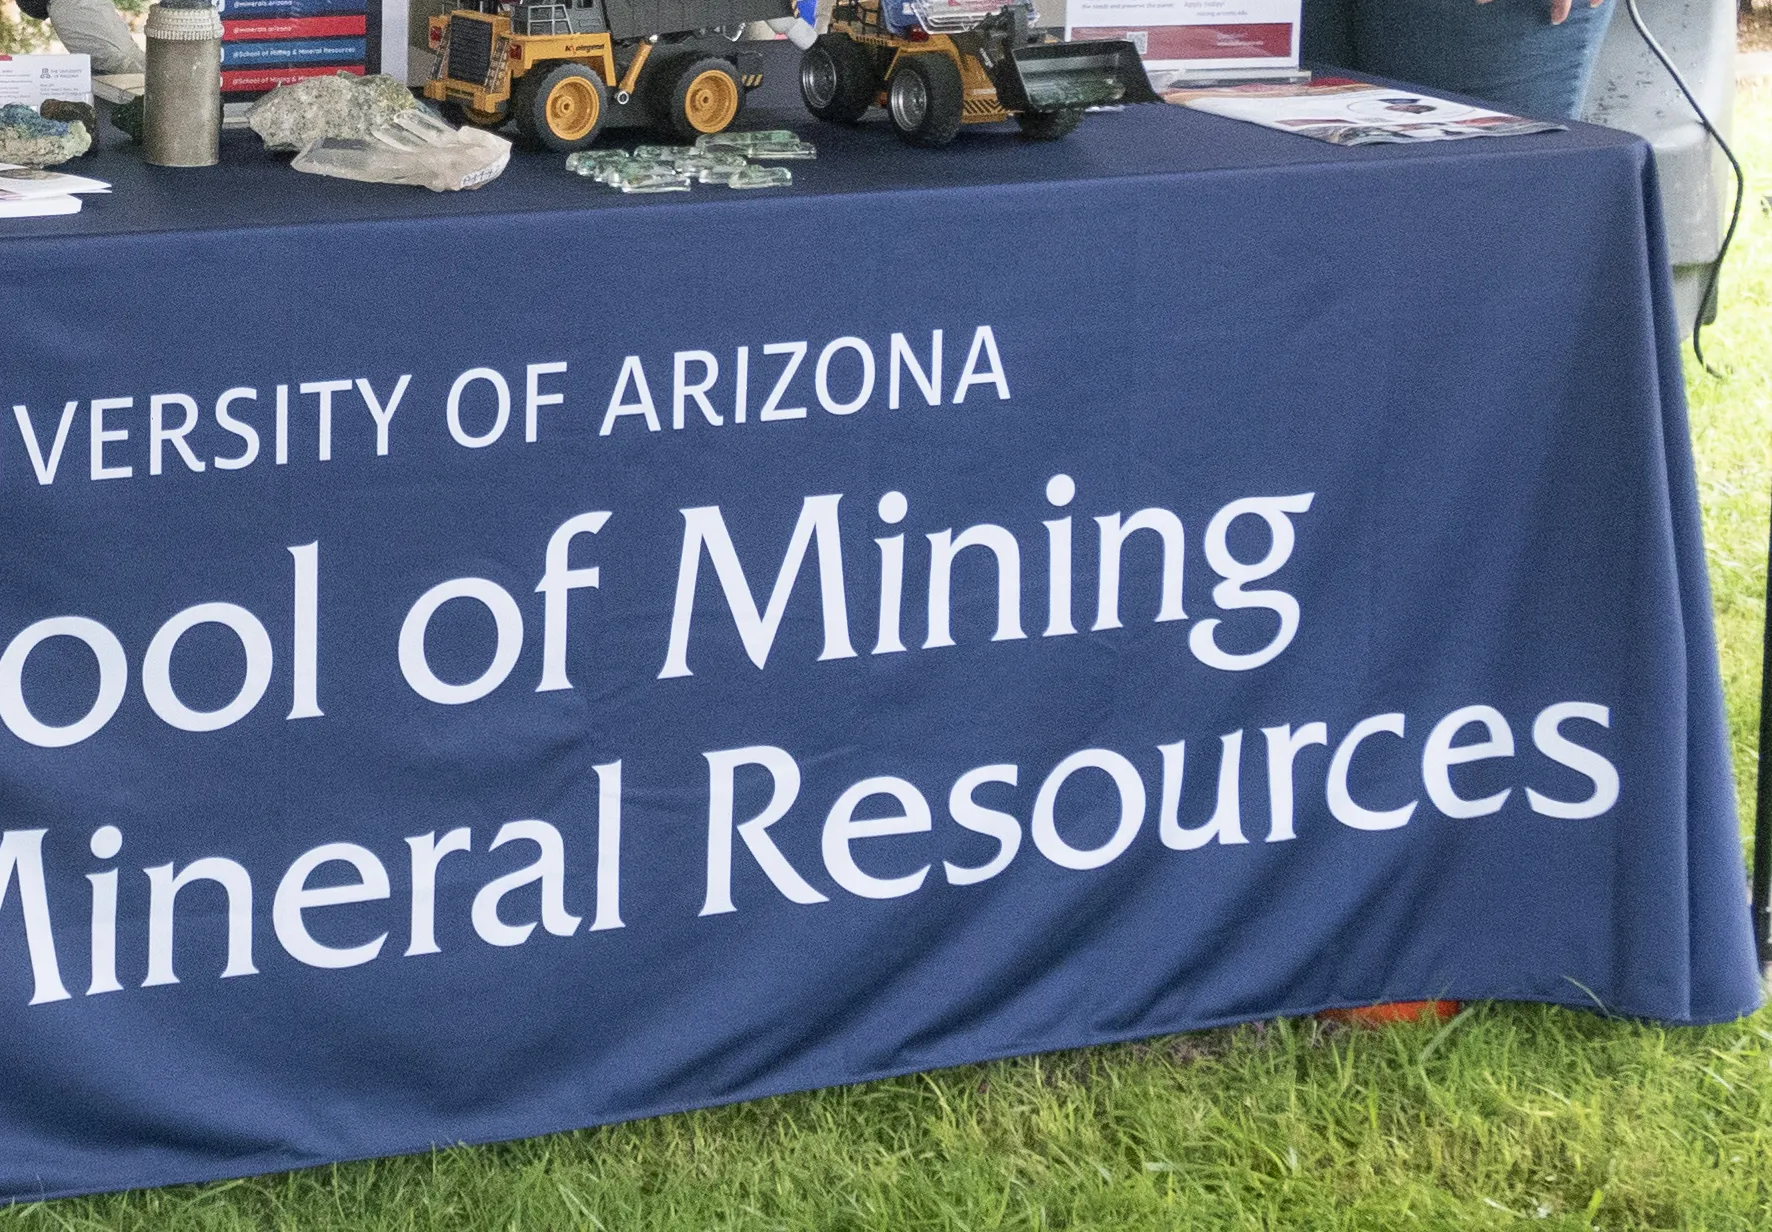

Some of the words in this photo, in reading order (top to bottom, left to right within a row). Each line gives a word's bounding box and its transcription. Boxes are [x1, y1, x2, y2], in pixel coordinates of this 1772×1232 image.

[233, 50, 260, 58] @School
[446, 361, 568, 448] OF
[599, 325, 1011, 436] ARIZONA
[398, 510, 613, 705] of
[657, 473, 1315, 679] Mining
[698, 701, 1620, 917] Resources
